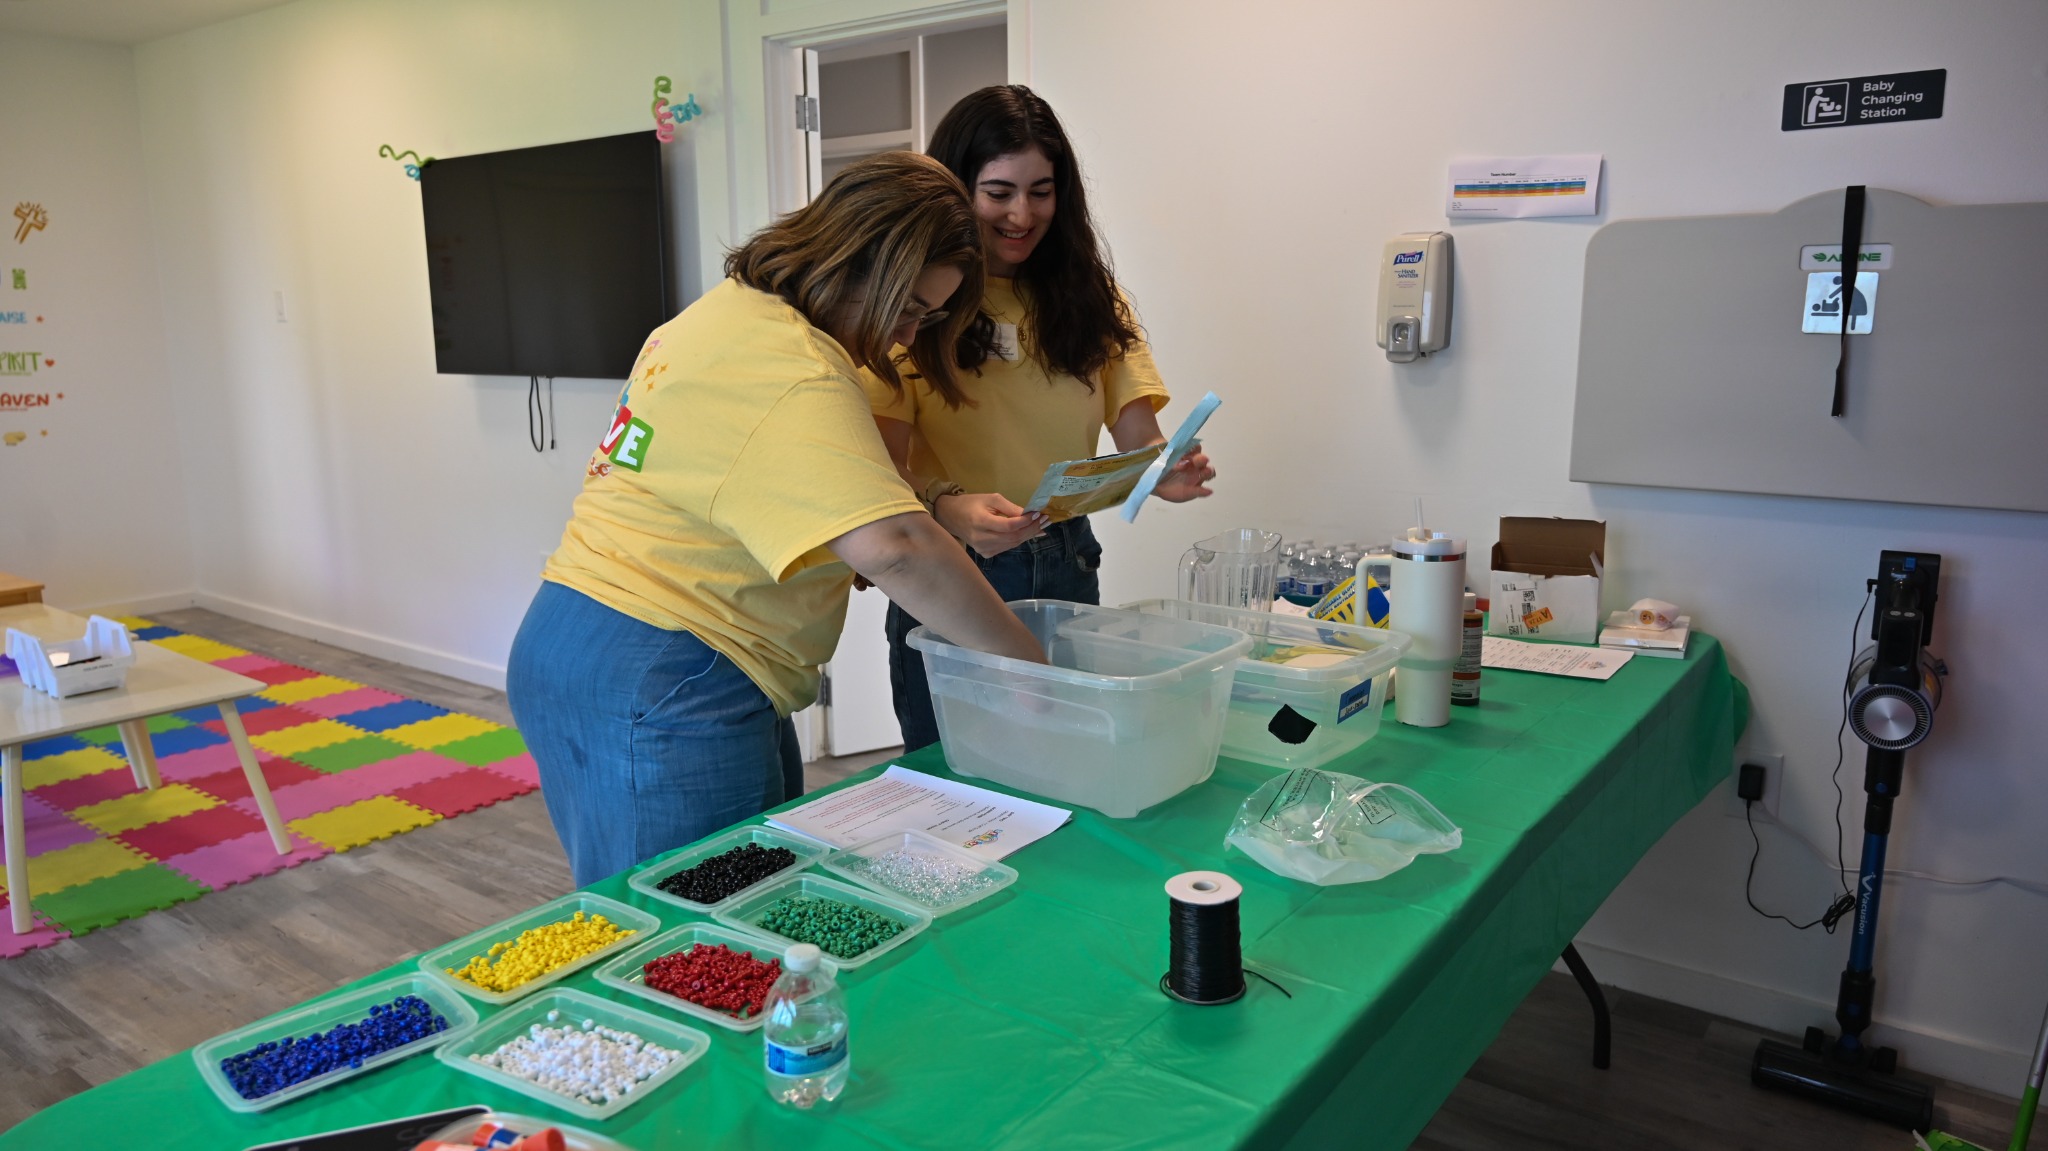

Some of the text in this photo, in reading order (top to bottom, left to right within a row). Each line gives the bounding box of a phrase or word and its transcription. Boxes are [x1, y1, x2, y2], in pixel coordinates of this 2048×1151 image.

[1862, 81, 1895, 93] Baby
[1861, 91, 1924, 106] Changing
[1860, 106, 1906, 119] Station
[1396, 253, 1420, 264] Purell
[1859, 892, 1870, 935] Vacusion
